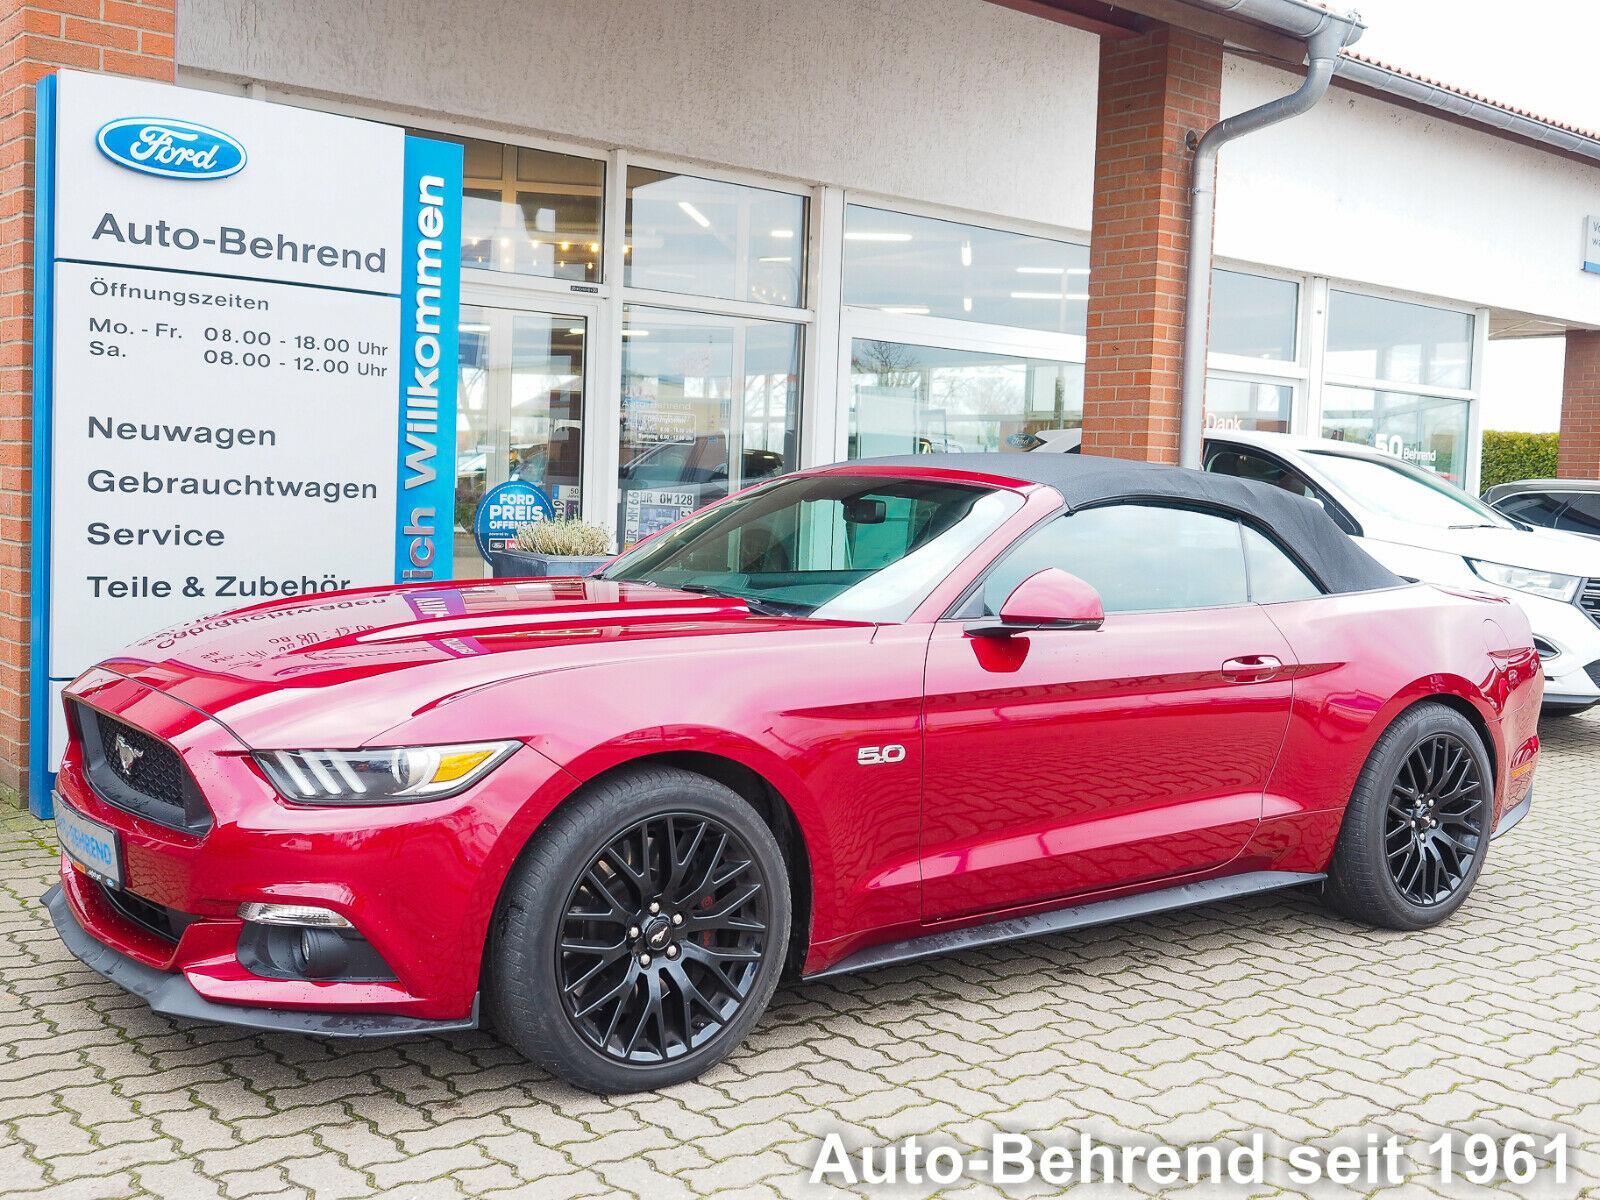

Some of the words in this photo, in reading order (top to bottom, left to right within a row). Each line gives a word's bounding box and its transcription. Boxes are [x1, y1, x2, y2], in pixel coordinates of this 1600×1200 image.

[130, 125, 217, 172] Ford
[92, 213, 387, 273] Auto-Behrend
[89, 277, 269, 311] Öffnungszeiten
[89, 317, 134, 335] Mo.
[155, 322, 183, 339] Fr.
[203, 327, 272, 346] 08.00
[294, 335, 350, 353] 18.00
[358, 341, 388, 356] Uhr
[404, 174, 444, 490] Willkommen
[89, 340, 126, 358] Sa.
[203, 349, 271, 368] 08.00
[294, 357, 349, 374] 12.00
[357, 362, 388, 377] Uhr
[88, 416, 276, 449] Neuwagen
[1205, 412, 1242, 432] Dank
[87, 470, 378, 503] Gebrauchtwagen
[499, 493, 535, 505] FORD
[675, 494, 693, 506] 128
[489, 504, 544, 520] PREIS
[87, 522, 226, 546] Service
[403, 507, 435, 584] ich
[87, 575, 172, 598] Teile
[183, 576, 205, 598] &
[216, 573, 351, 598] Zubehör
